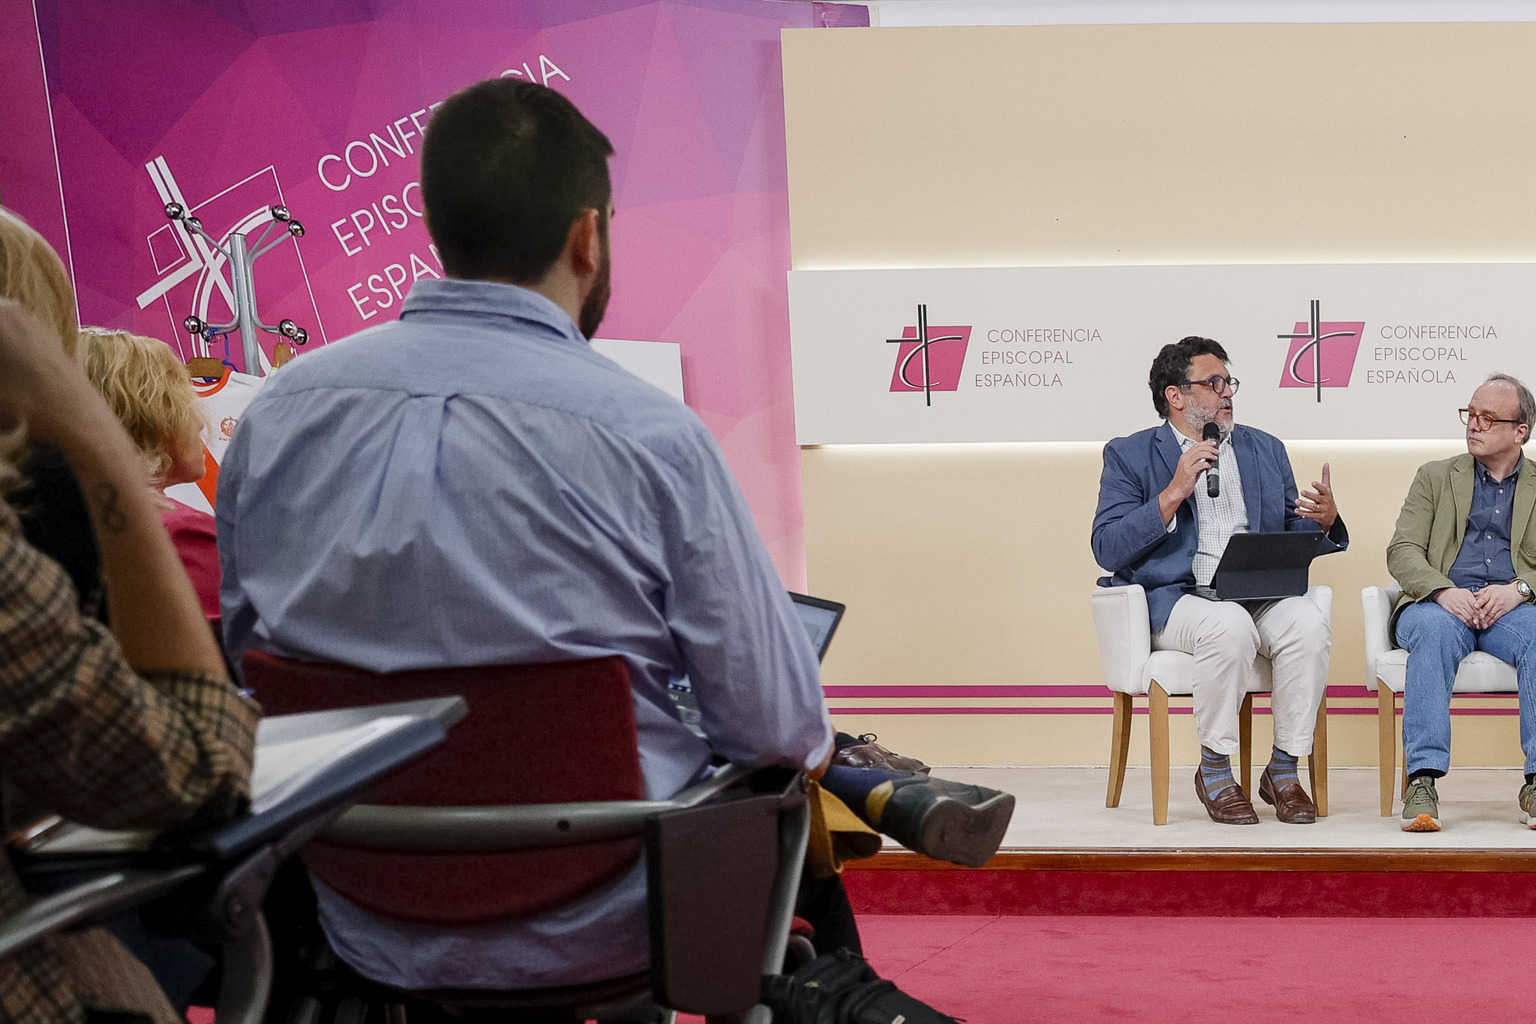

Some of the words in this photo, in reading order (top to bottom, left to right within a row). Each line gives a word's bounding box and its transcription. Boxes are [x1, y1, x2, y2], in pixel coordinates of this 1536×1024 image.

[986, 328, 1103, 343] CONFERENCIA
[1380, 325, 1498, 340] CONFERENCIA
[981, 350, 1074, 365] EPISCOPAL
[1374, 347, 1468, 361] EPISCOPAL
[975, 371, 1063, 387] ESPAÑOLA
[1367, 367, 1457, 384] ESPAÑOLA
